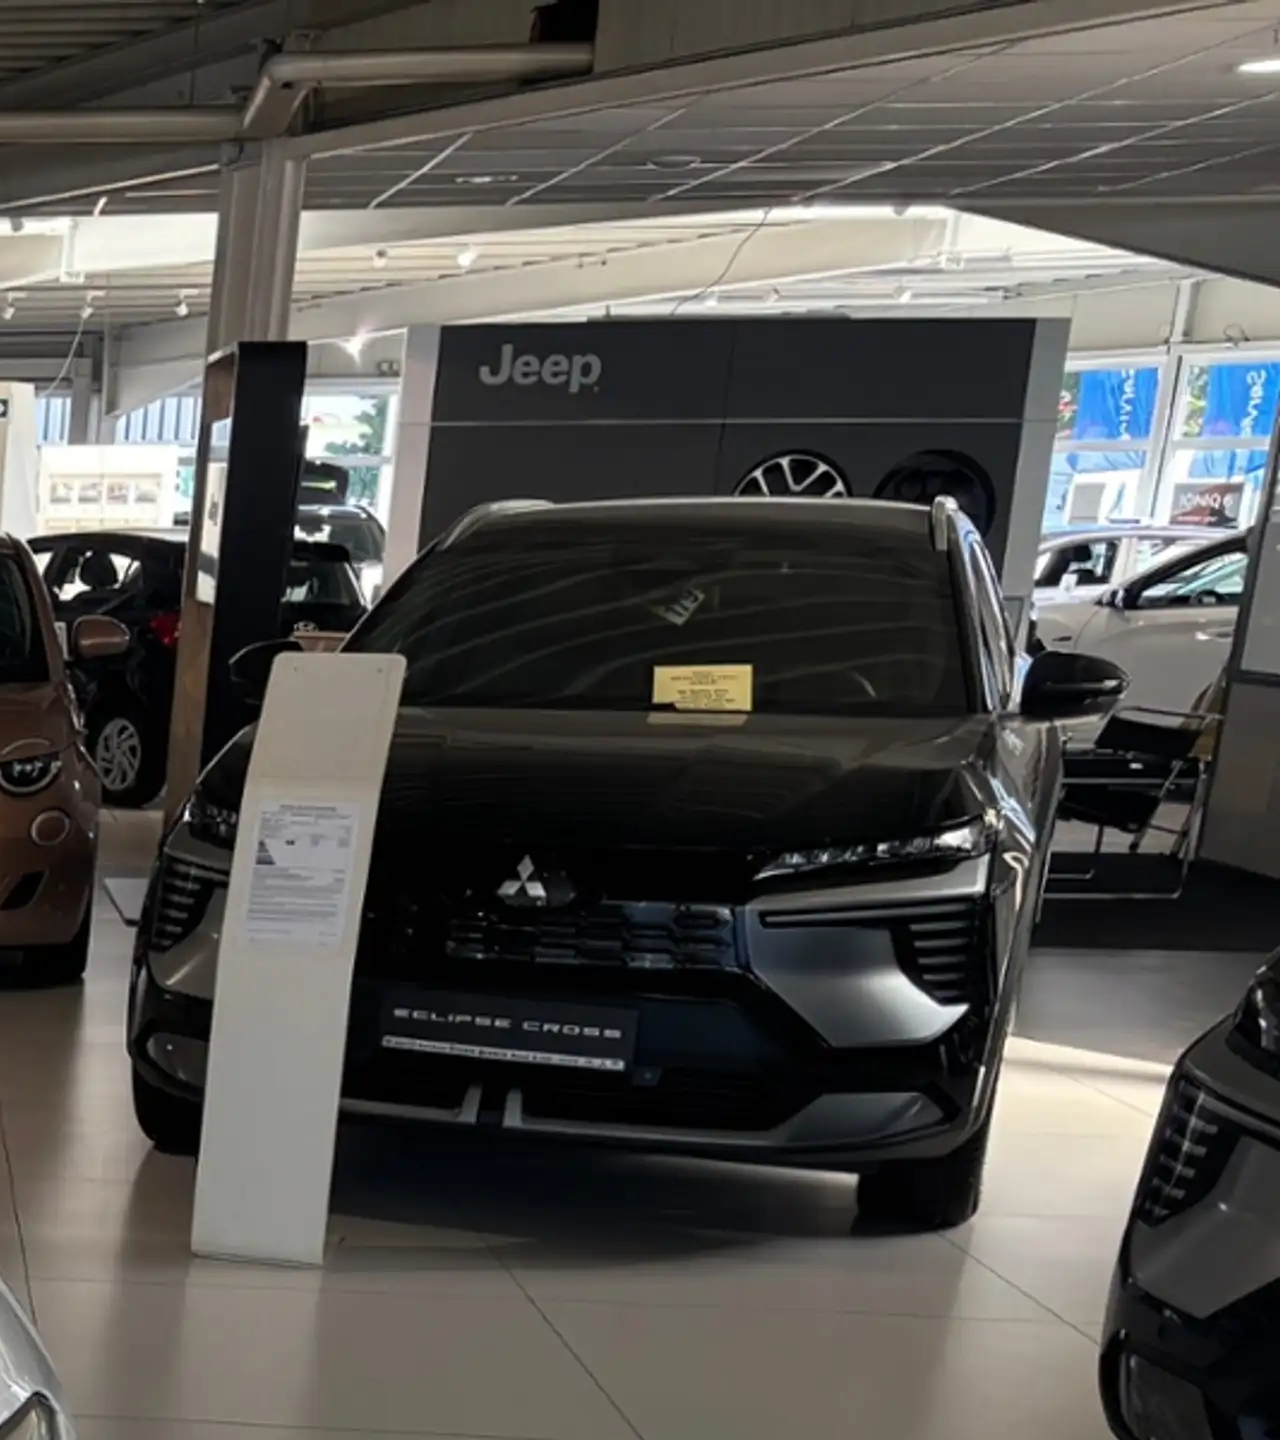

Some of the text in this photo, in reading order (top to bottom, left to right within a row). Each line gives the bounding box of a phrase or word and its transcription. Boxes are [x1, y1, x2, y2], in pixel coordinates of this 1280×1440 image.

[479, 343, 602, 393] Jeep
[393, 1008, 622, 1039] ECLIPSE CROSS
